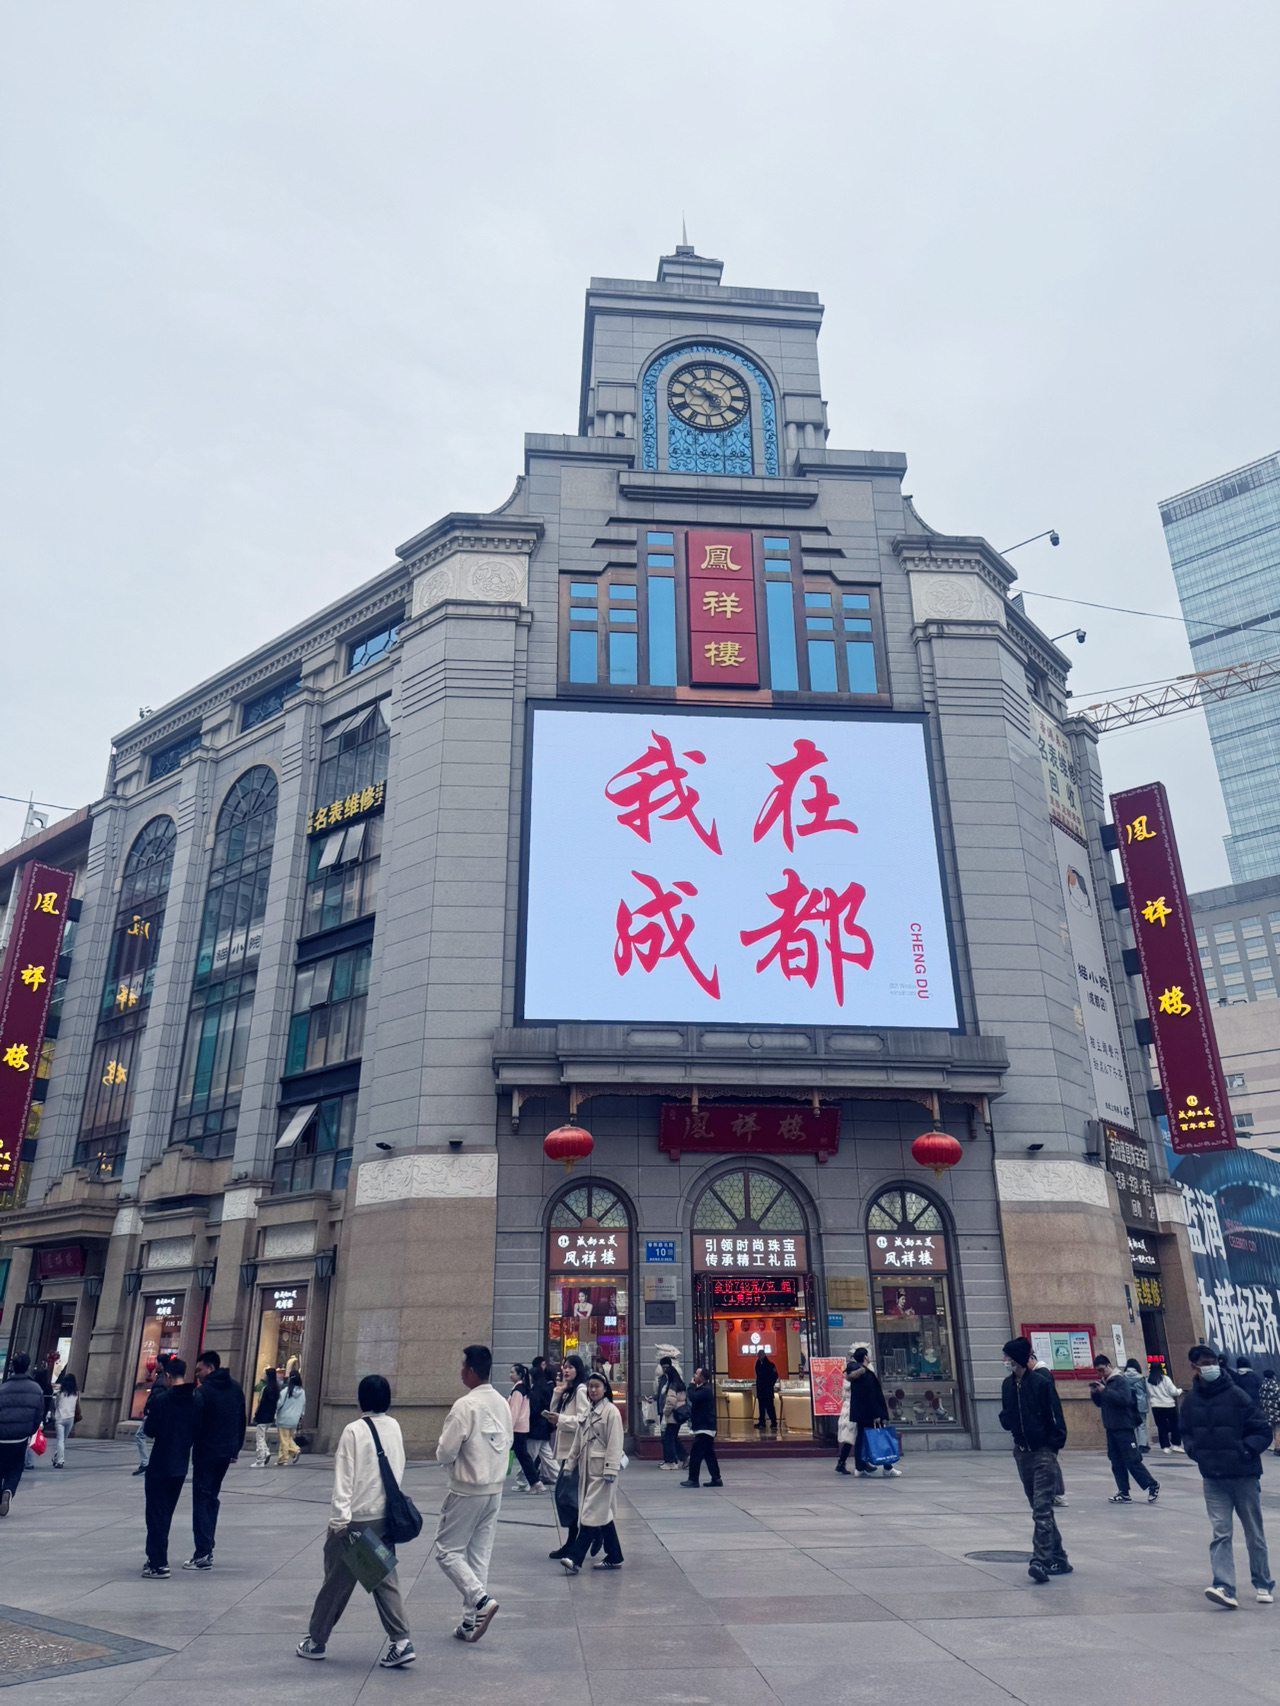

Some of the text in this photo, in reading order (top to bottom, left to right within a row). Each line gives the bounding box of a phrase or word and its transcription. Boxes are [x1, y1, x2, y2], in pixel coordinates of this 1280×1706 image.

[700, 544, 746, 667] 鳳祥樓
[1038, 734, 1077, 786] 名表维修
[314, 786, 375, 831] 名表维修
[605, 729, 858, 855] 我在
[614, 868, 874, 1007] 成都
[910, 922, 929, 1000] CHENG DU
[563, 1248, 616, 1269] 凤祥楼
[656, 1248, 666, 1257] 10
[705, 1238, 795, 1252] 引领时尚珠宝
[705, 1253, 796, 1267] 传承精工礼品
[884, 1250, 933, 1268] 凤祥楼
[1198, 1278, 1280, 1355] 为新经济
